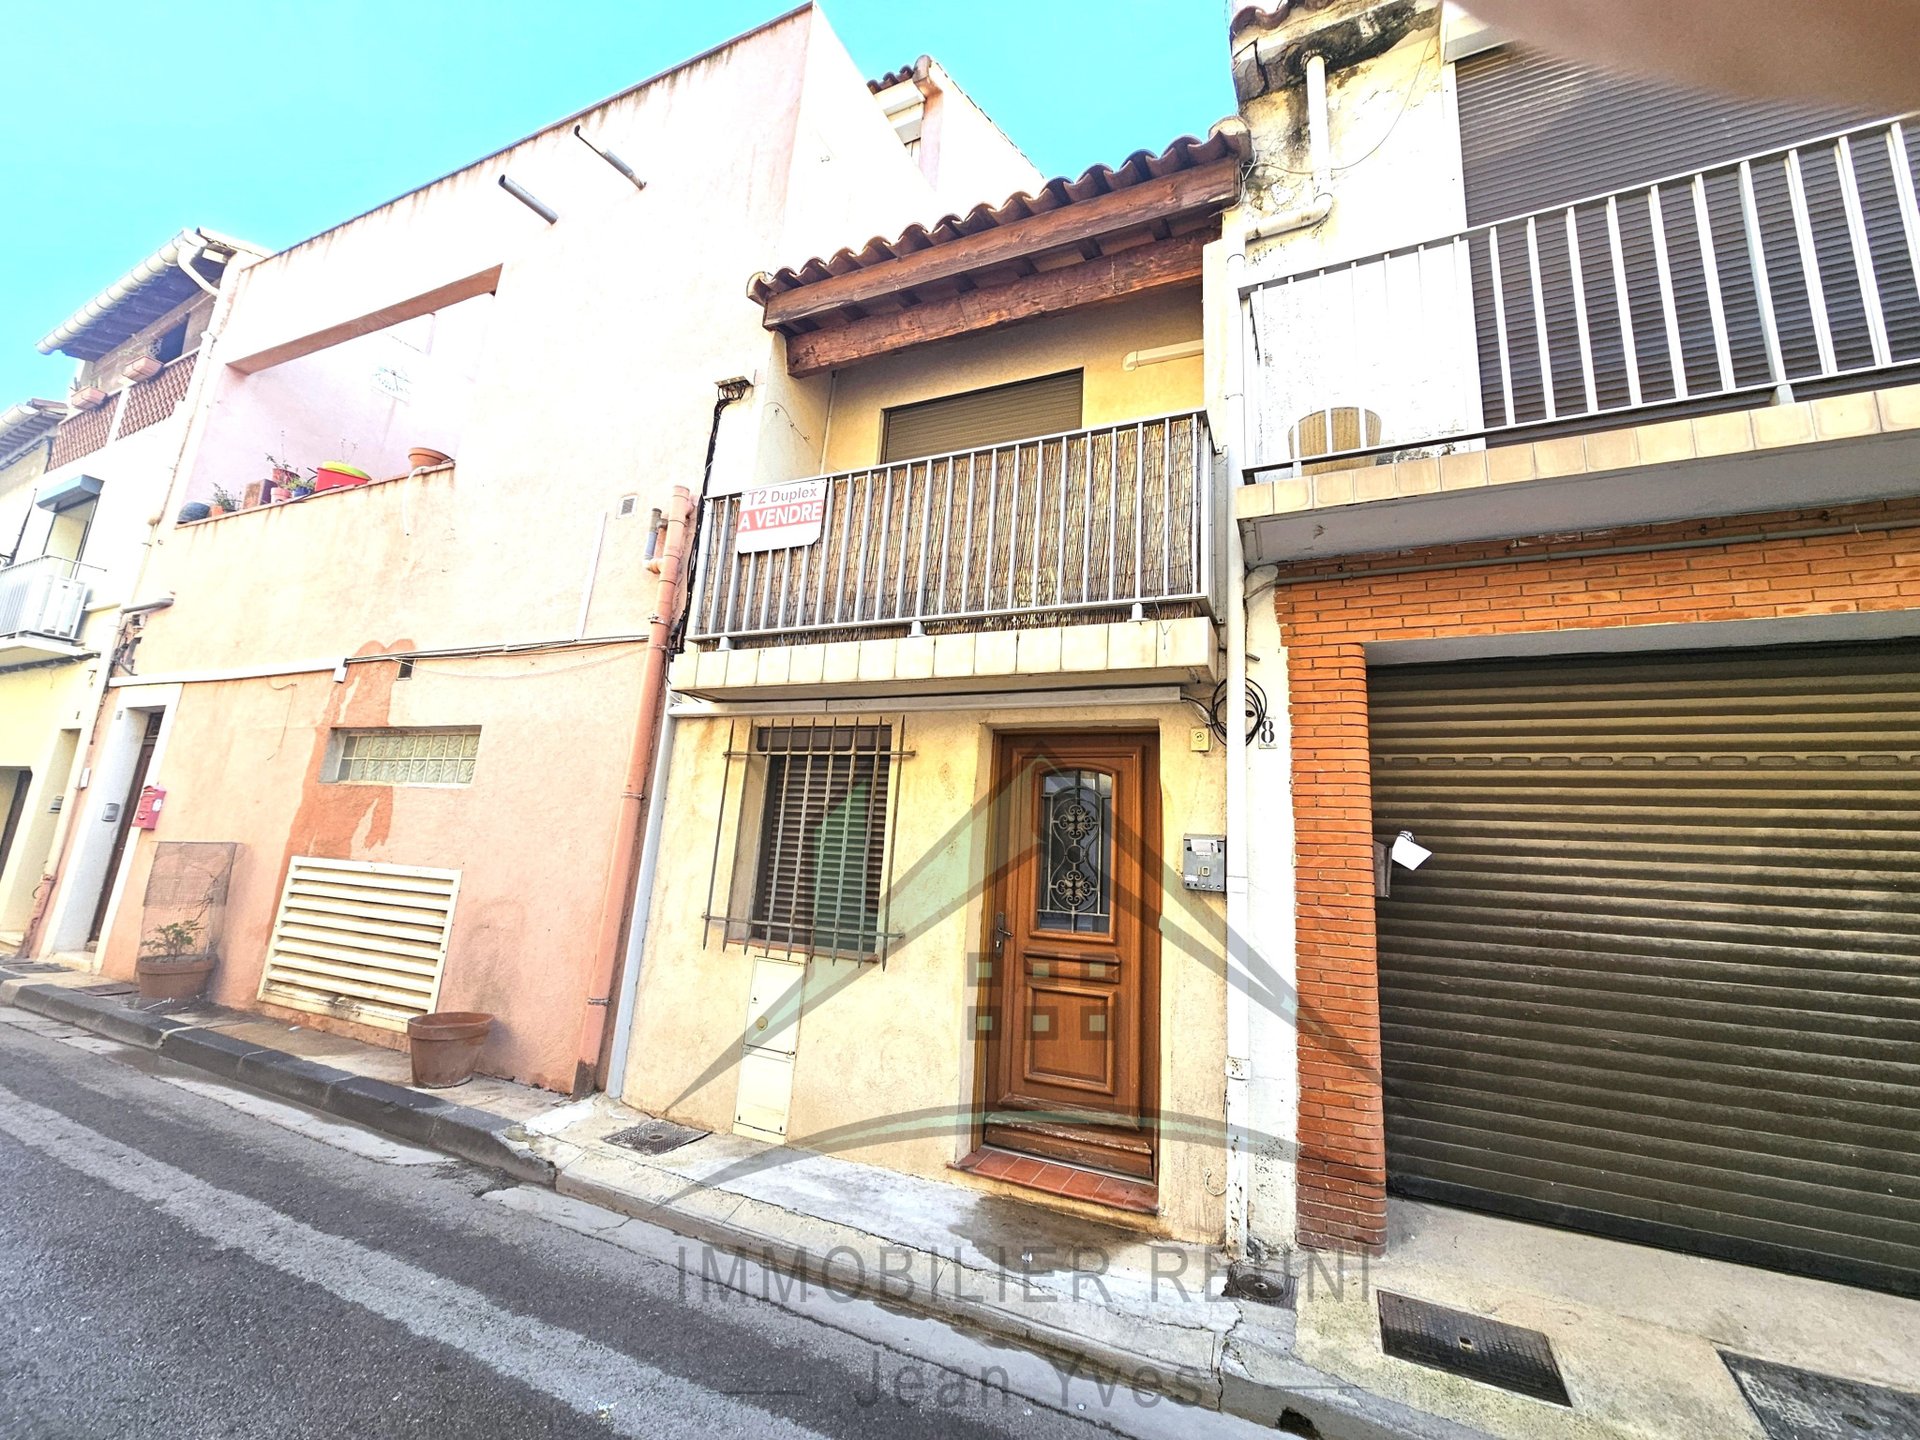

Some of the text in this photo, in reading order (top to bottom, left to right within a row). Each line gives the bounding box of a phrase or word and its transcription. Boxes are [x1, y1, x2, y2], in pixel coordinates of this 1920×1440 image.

[748, 486, 818, 506] T2 Duplex
[739, 503, 822, 530] A VENDRE
[1261, 720, 1275, 743] 8
